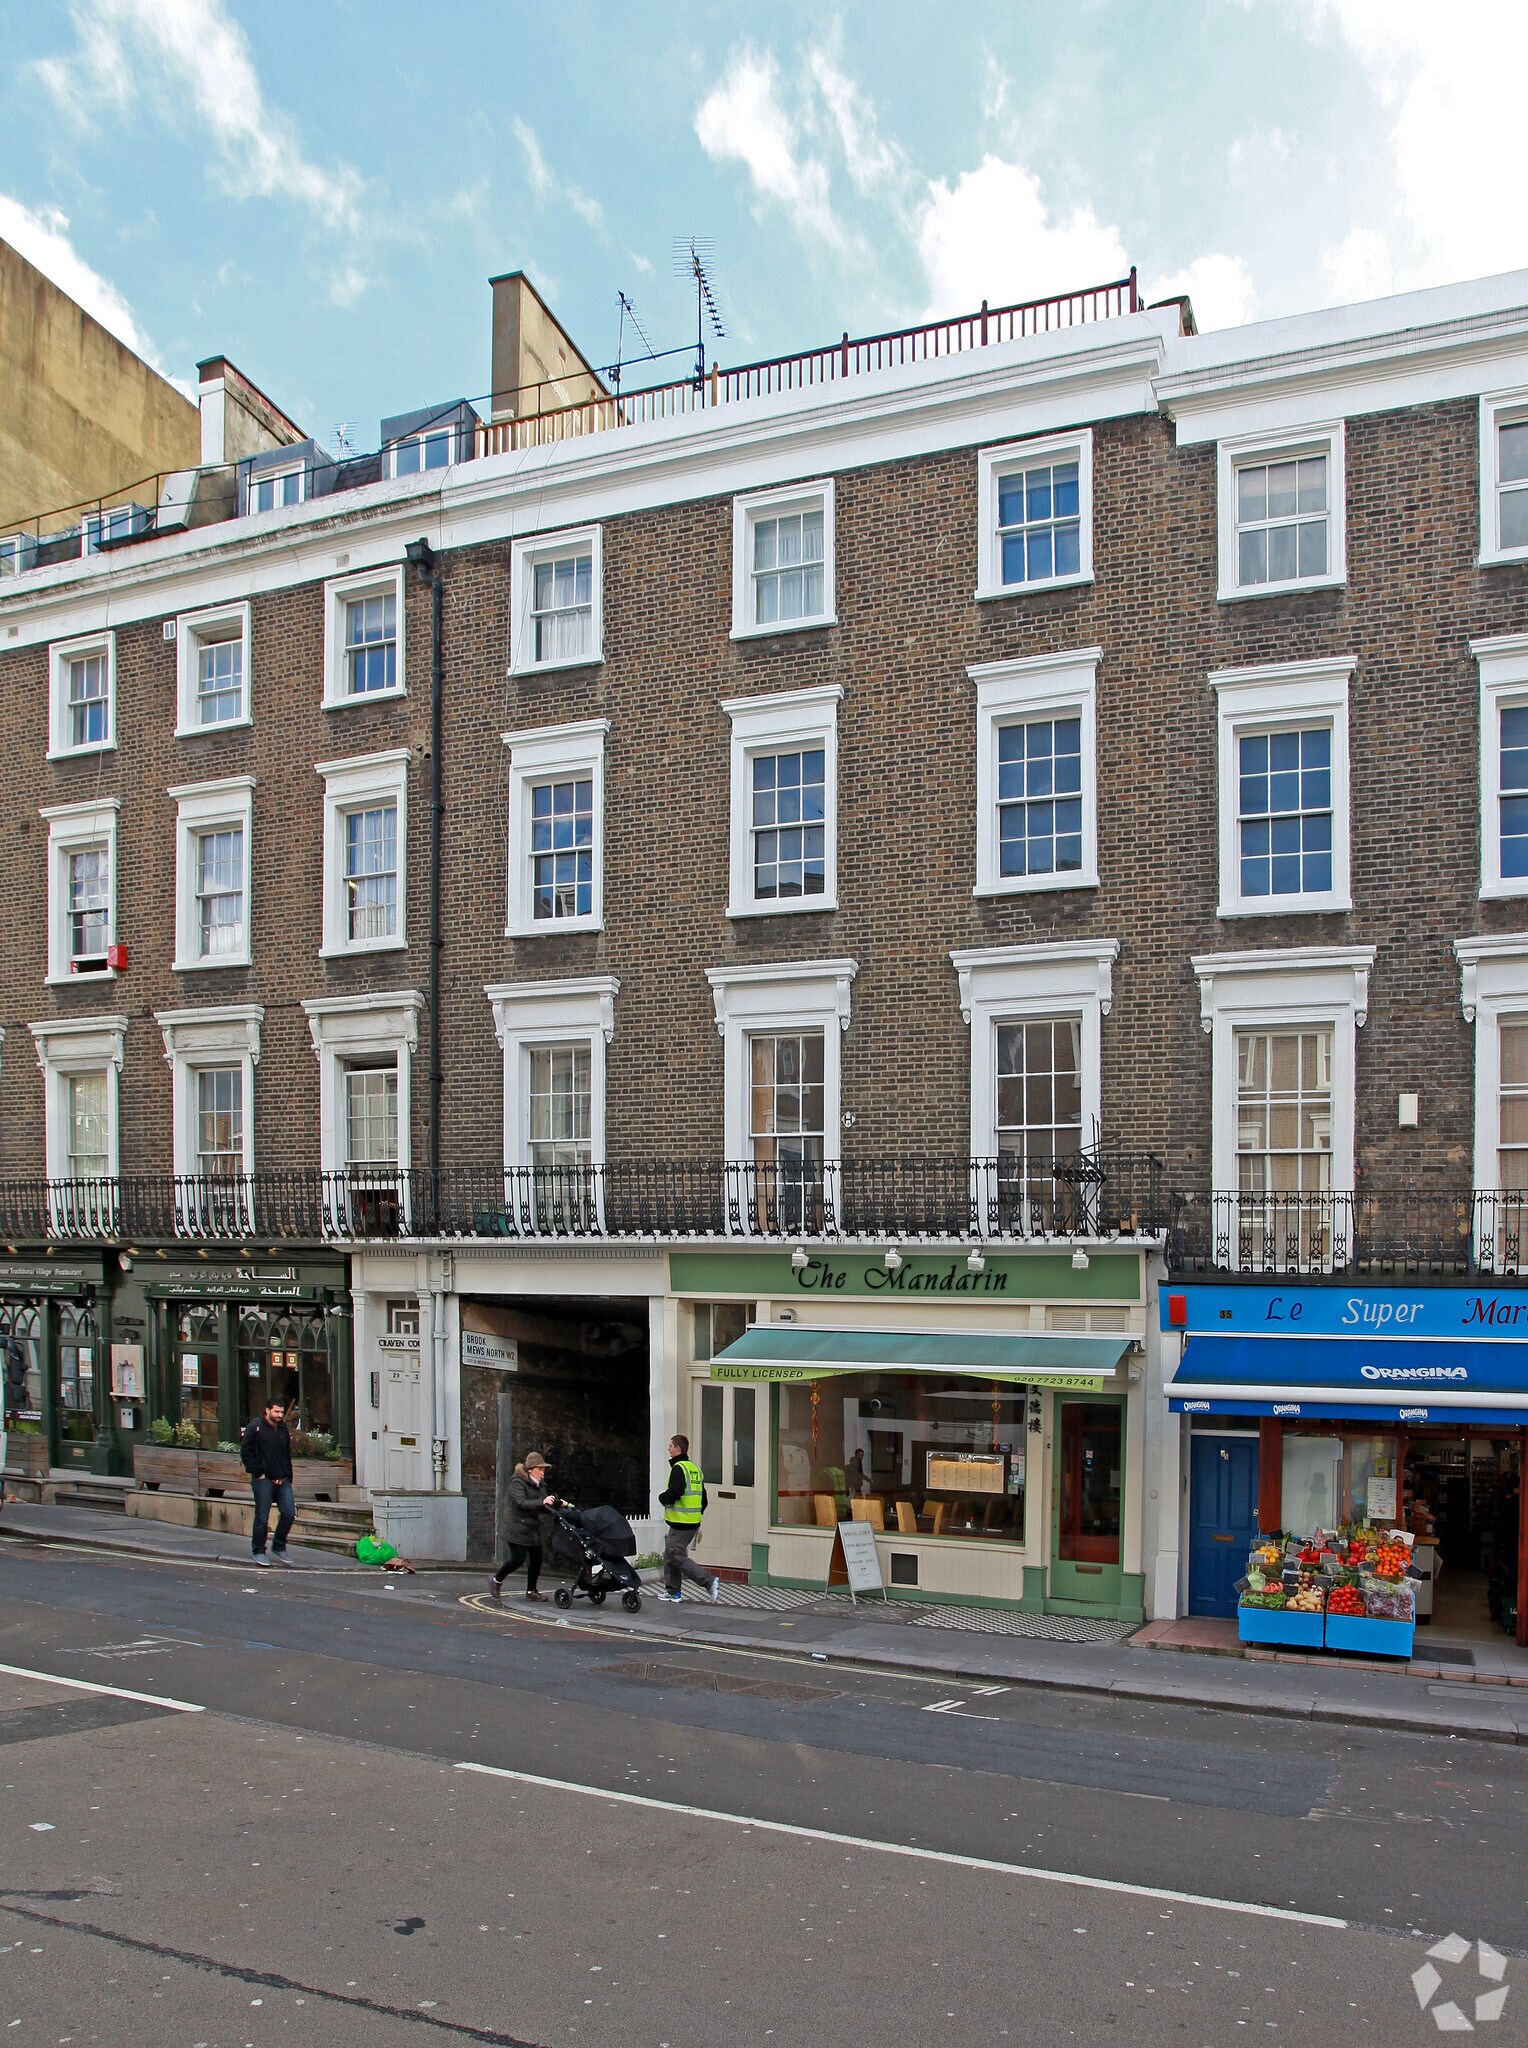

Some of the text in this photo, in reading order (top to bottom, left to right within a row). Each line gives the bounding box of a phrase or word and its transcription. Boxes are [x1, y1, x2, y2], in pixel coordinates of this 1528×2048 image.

[9, 1267, 35, 1275] Traditional
[35, 1268, 52, 1276] Village
[54, 1268, 83, 1276] Restaurant
[792, 1261, 1008, 1290] The Mandarin
[1220, 1310, 1232, 1319] 35
[1264, 1296, 1528, 1329] Le Super Mar
[378, 1339, 405, 1347] CRAVEN
[466, 1334, 487, 1345] BROOK
[466, 1345, 515, 1361] MEWS NORTH W2
[717, 1368, 804, 1378] FULLY LICENSED
[1361, 1366, 1468, 1380] ORANGINA
[1037, 1377, 1063, 1385] 7723
[1066, 1378, 1094, 1387] 8744
[1183, 1401, 1210, 1412] ORANGINA
[1273, 1404, 1301, 1415] ORANGINA
[1399, 1408, 1428, 1420] ORANGINA
